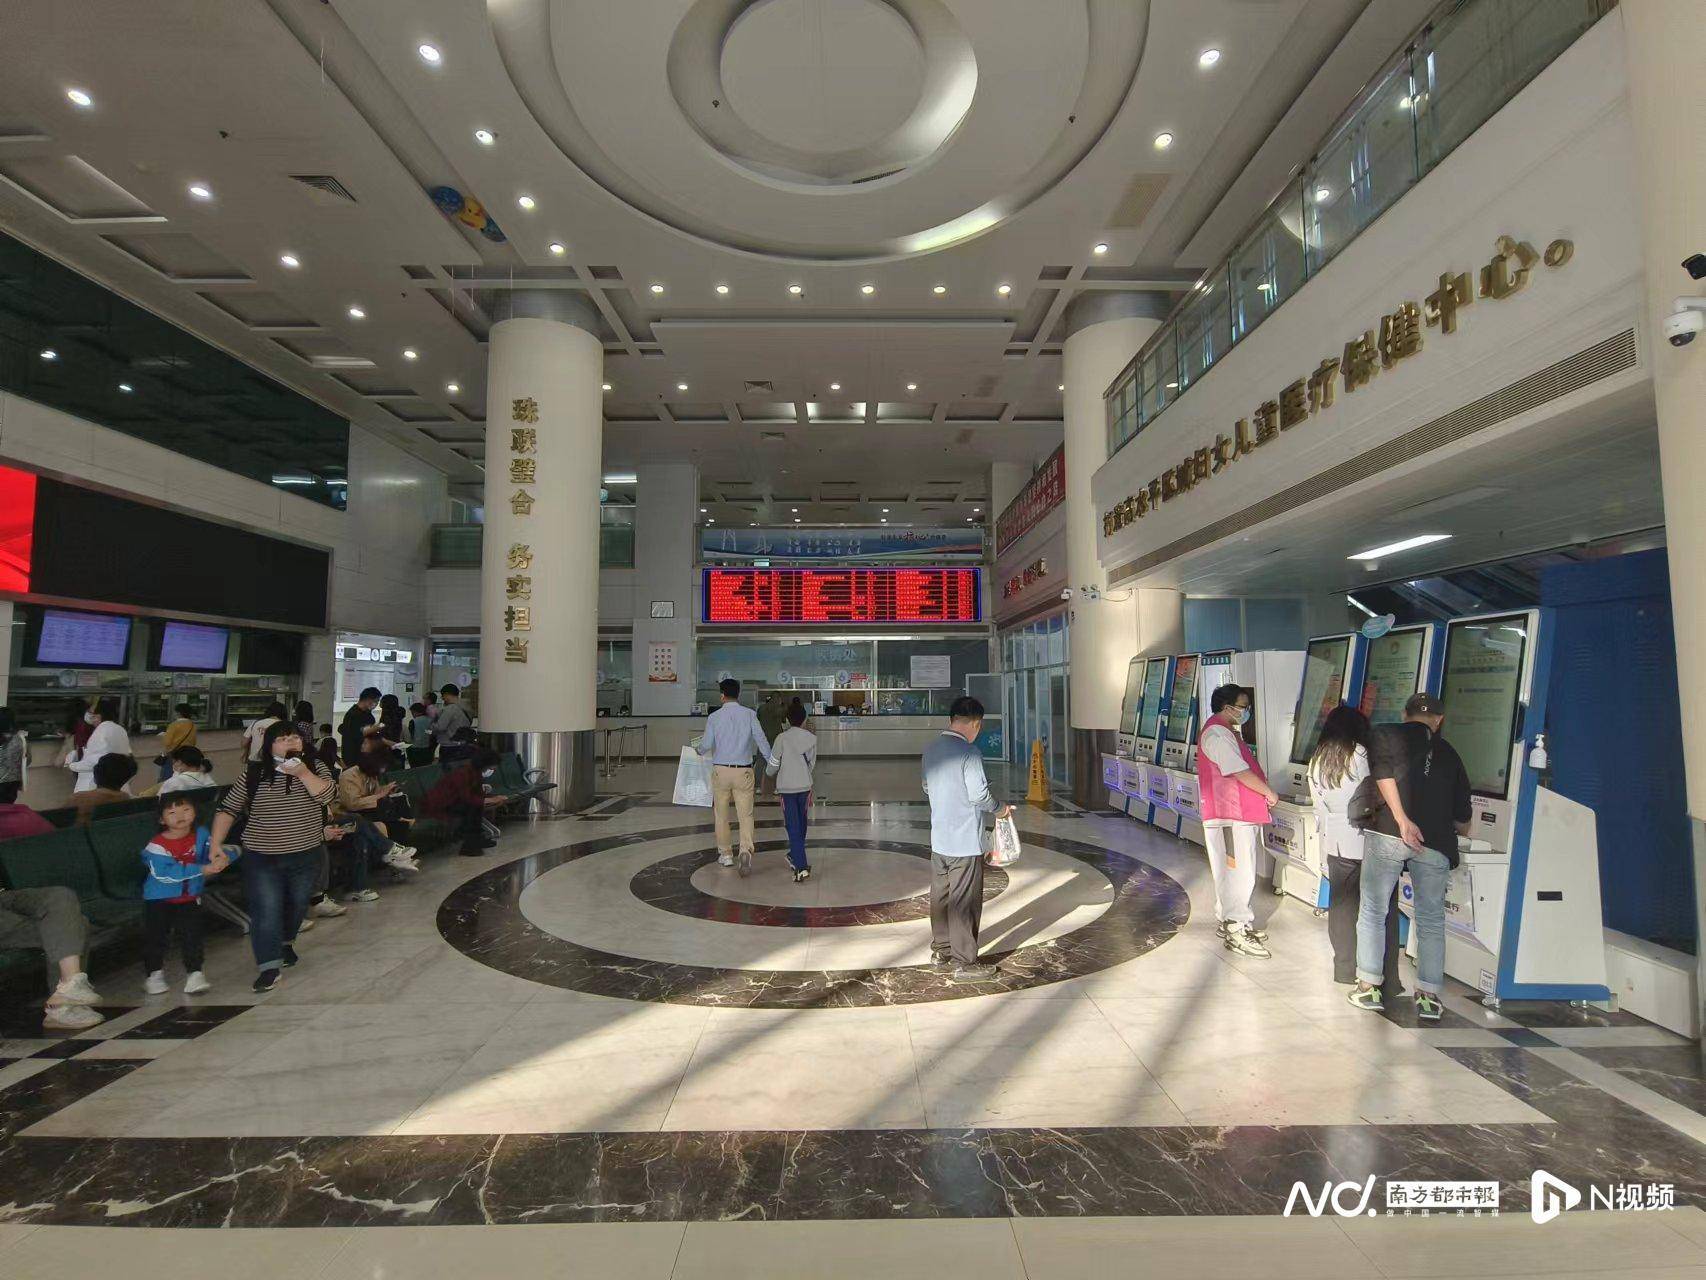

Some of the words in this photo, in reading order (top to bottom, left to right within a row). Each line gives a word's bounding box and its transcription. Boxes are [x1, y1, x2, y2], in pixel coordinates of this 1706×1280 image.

[509, 397, 539, 515] 珠联璧合
[504, 543, 533, 663] 务实担当
